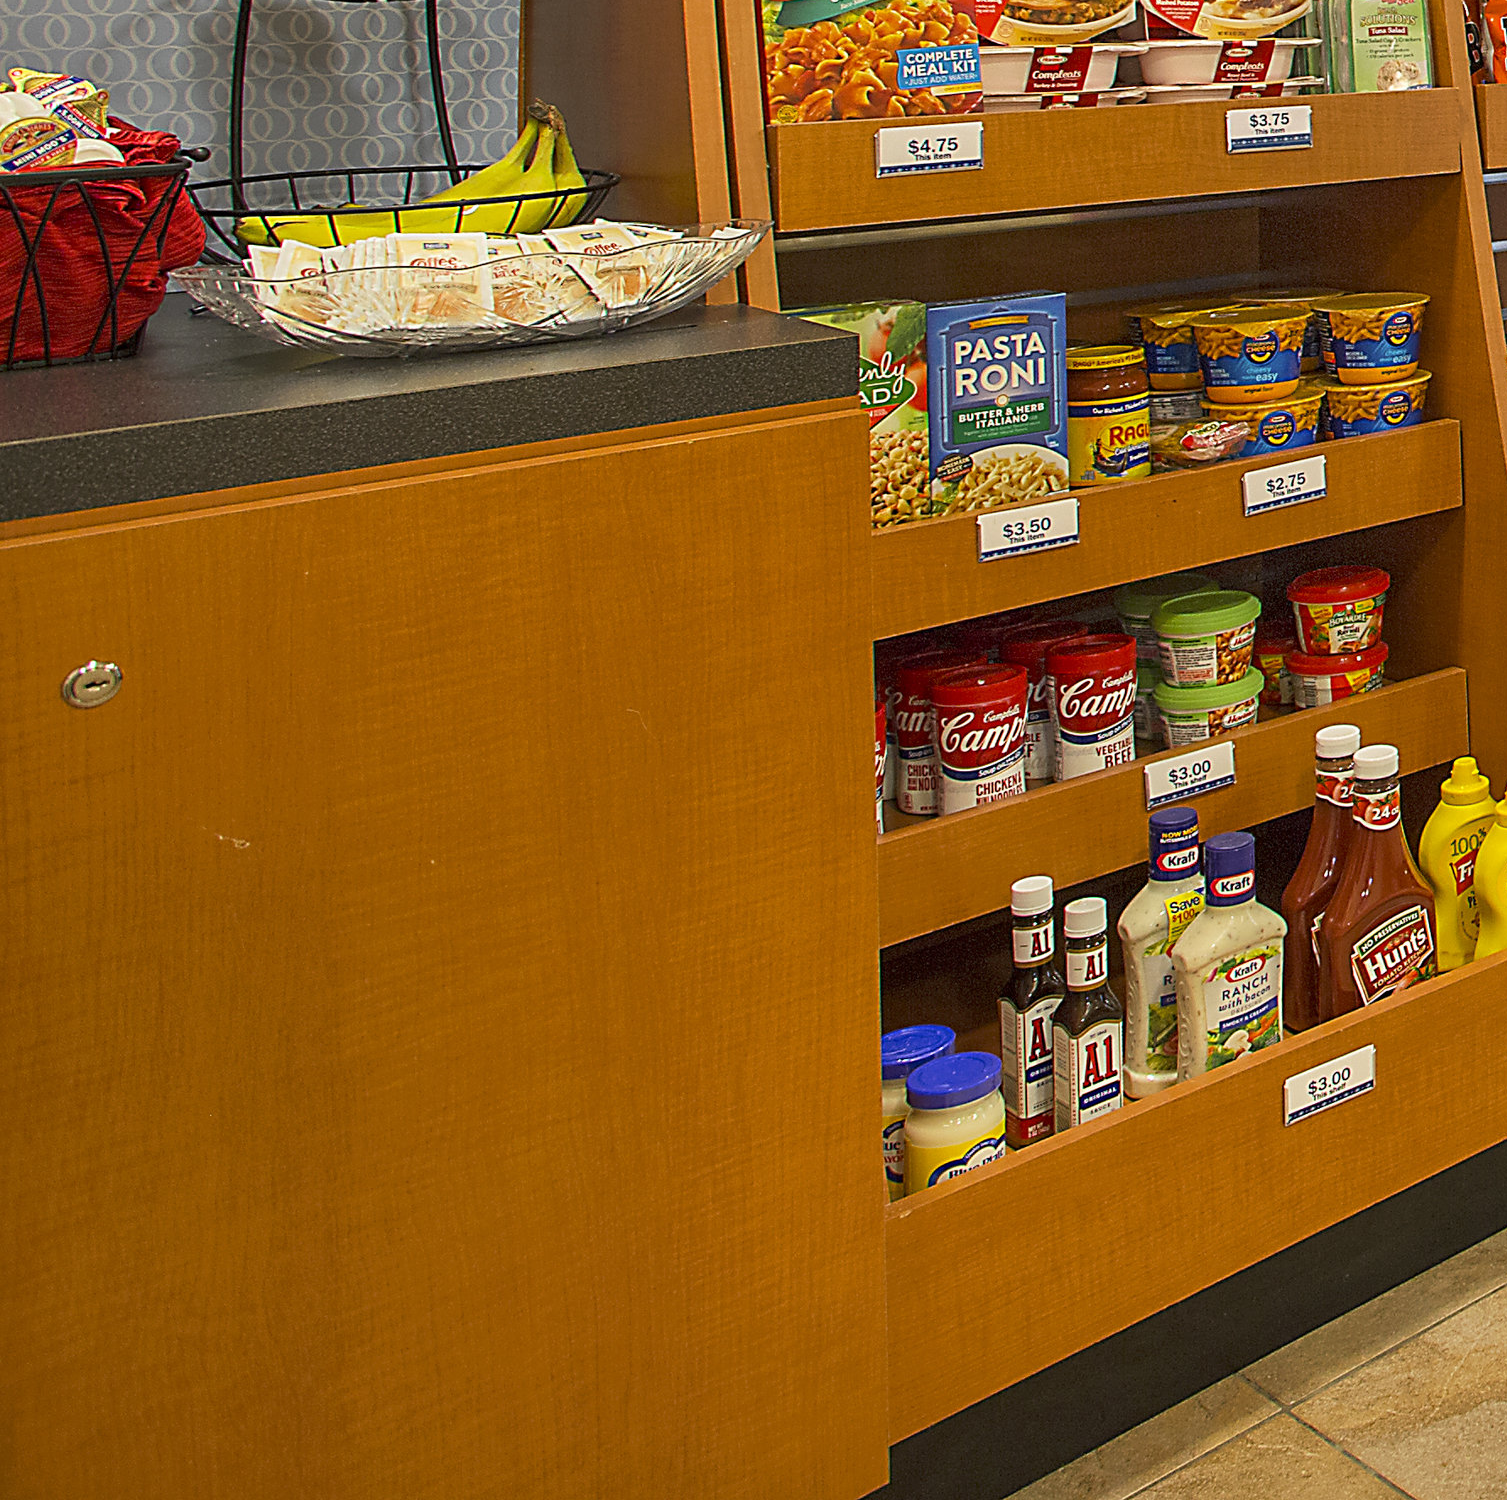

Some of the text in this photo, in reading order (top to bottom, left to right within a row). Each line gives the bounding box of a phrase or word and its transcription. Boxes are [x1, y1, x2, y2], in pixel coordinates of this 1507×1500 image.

[906, 49, 974, 64] COMPLETE
[903, 59, 977, 78] MEAL KIT
[1248, 111, 1290, 128] $3.75
[907, 137, 959, 155] $4.75
[953, 331, 1046, 366] PASTA
[955, 357, 1046, 397] RONI
[958, 402, 1045, 423] BUTTER & HERB
[975, 414, 1029, 430] ITALIANO
[1265, 472, 1308, 492] $2.75
[1002, 517, 1052, 539] $3.50
[1168, 760, 1212, 784] $3.00
[1167, 851, 1196, 868] Kraft
[1220, 876, 1251, 893] Kraft
[1233, 962, 1258, 978] Kraft
[1222, 972, 1269, 1000] RANCH
[1218, 984, 1271, 1012] with bacon
[1307, 1067, 1352, 1096] $3.00
